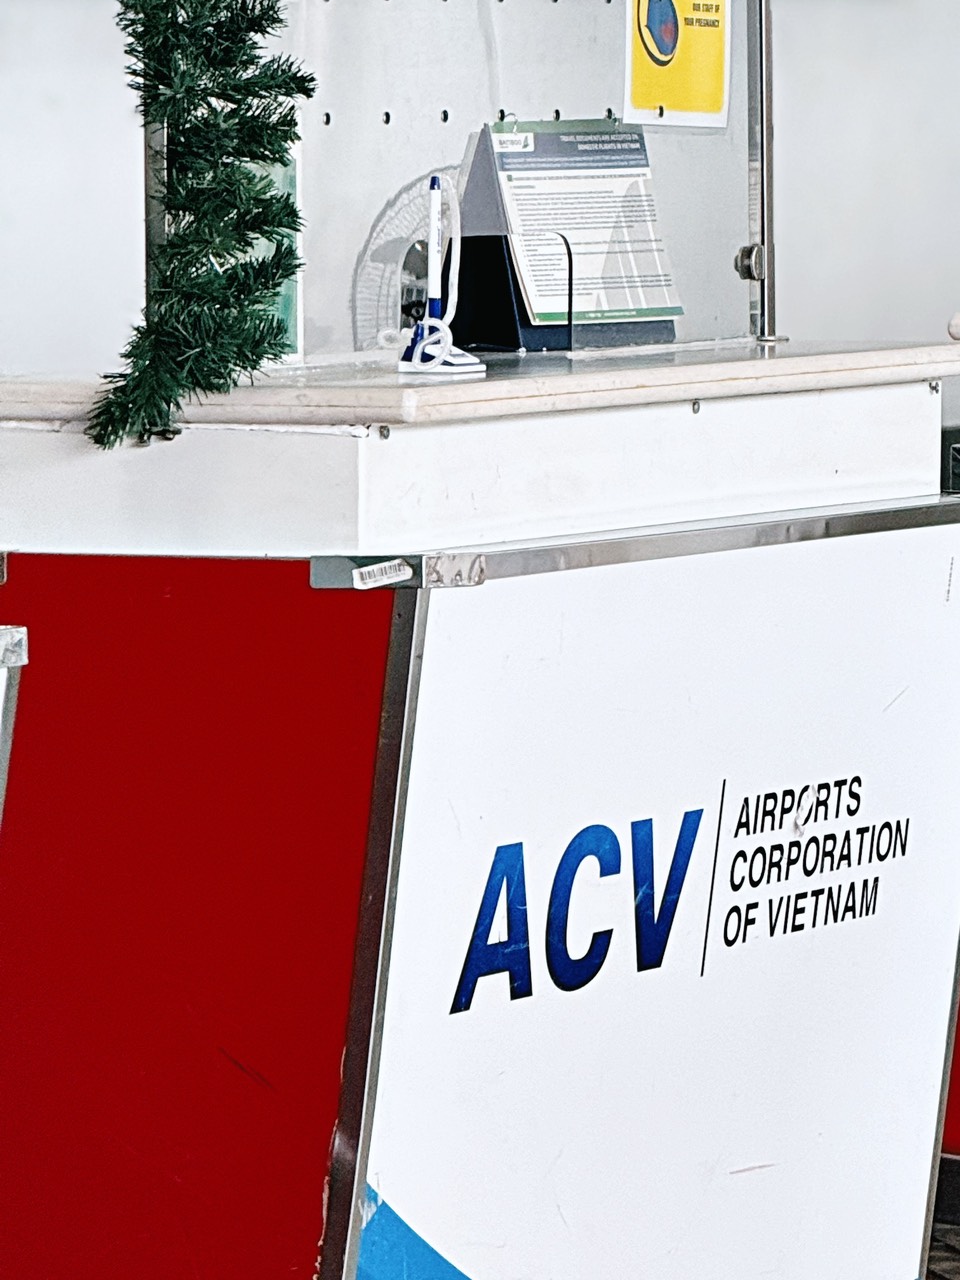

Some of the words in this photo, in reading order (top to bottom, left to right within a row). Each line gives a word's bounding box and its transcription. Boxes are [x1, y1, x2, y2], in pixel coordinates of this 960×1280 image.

[734, 775, 863, 838] AIRPORTS
[729, 817, 910, 892] CORPORATION
[449, 808, 704, 1015] ACV
[723, 902, 759, 947] OF
[769, 876, 879, 938] VIETNAM
